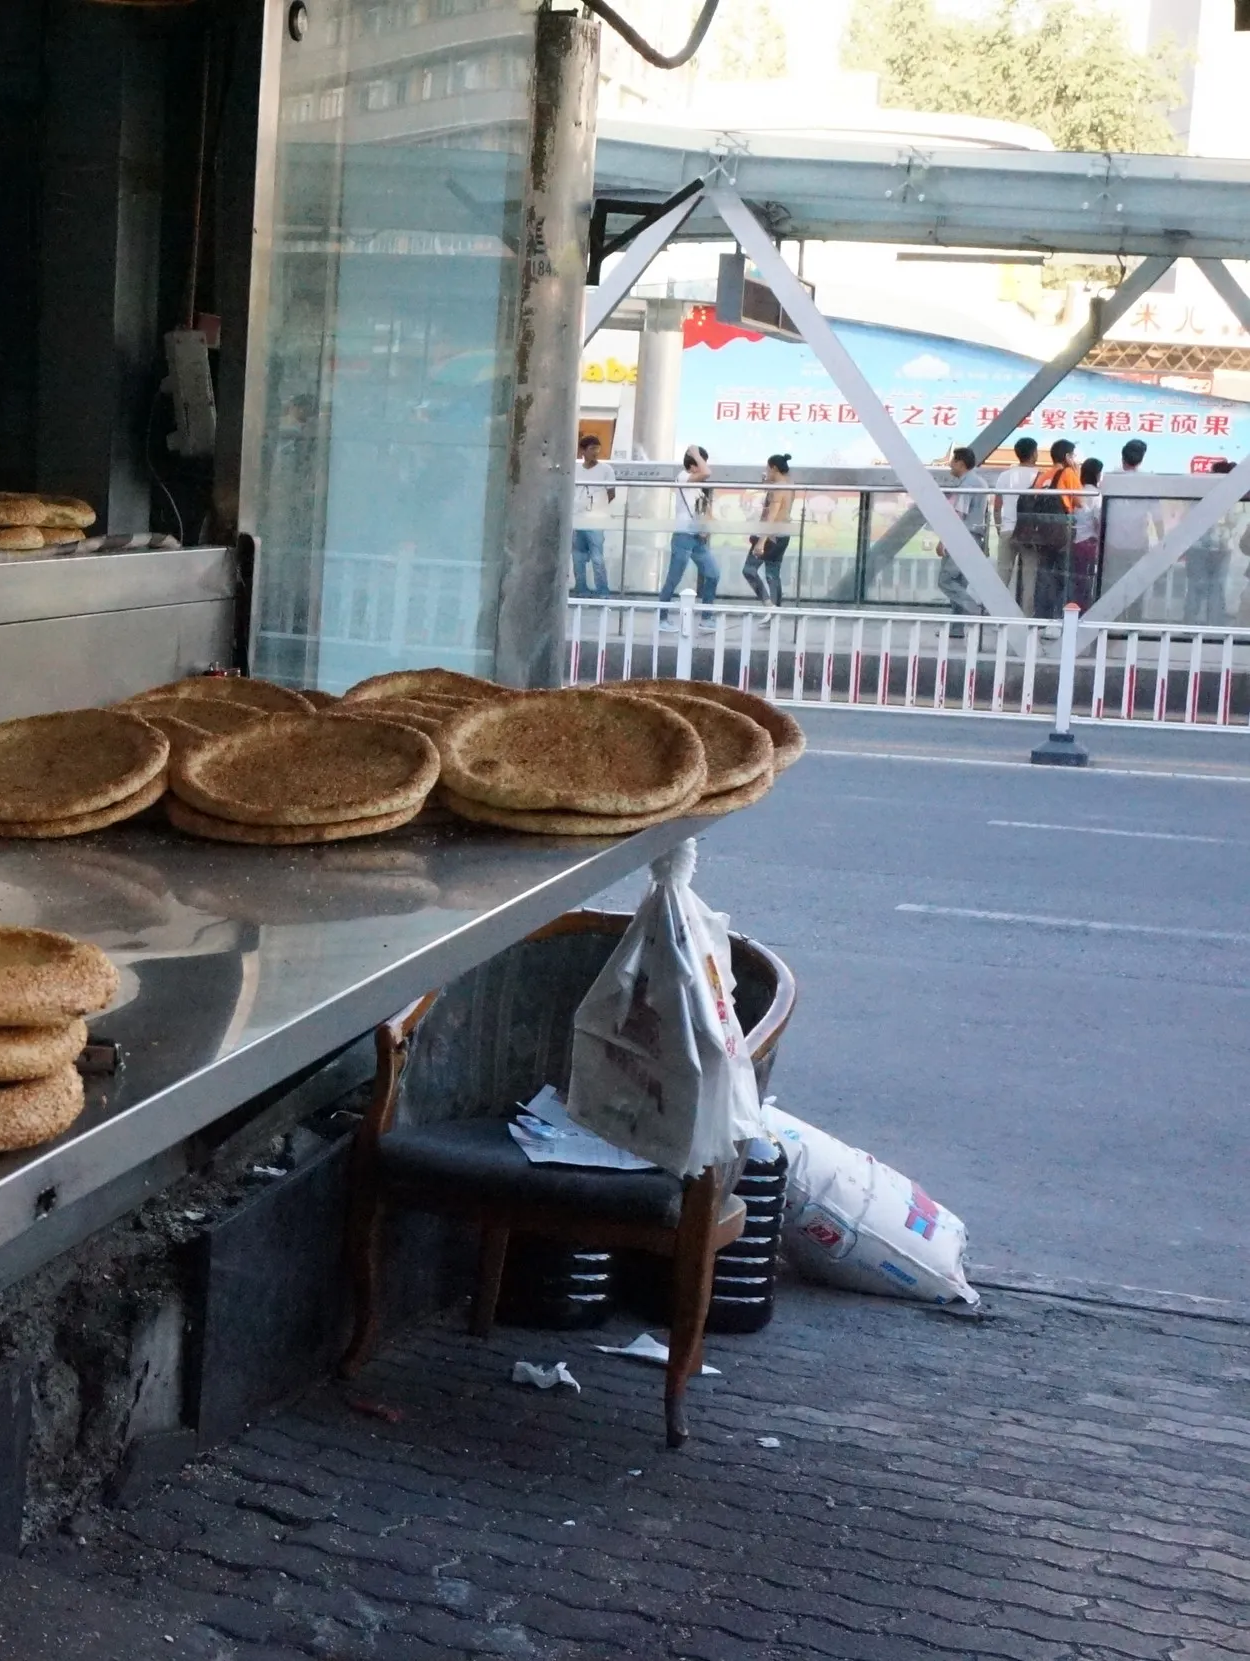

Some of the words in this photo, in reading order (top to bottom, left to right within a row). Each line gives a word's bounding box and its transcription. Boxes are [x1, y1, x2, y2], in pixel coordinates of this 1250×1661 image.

[716, 401, 958, 426] 同栽民族团之花
